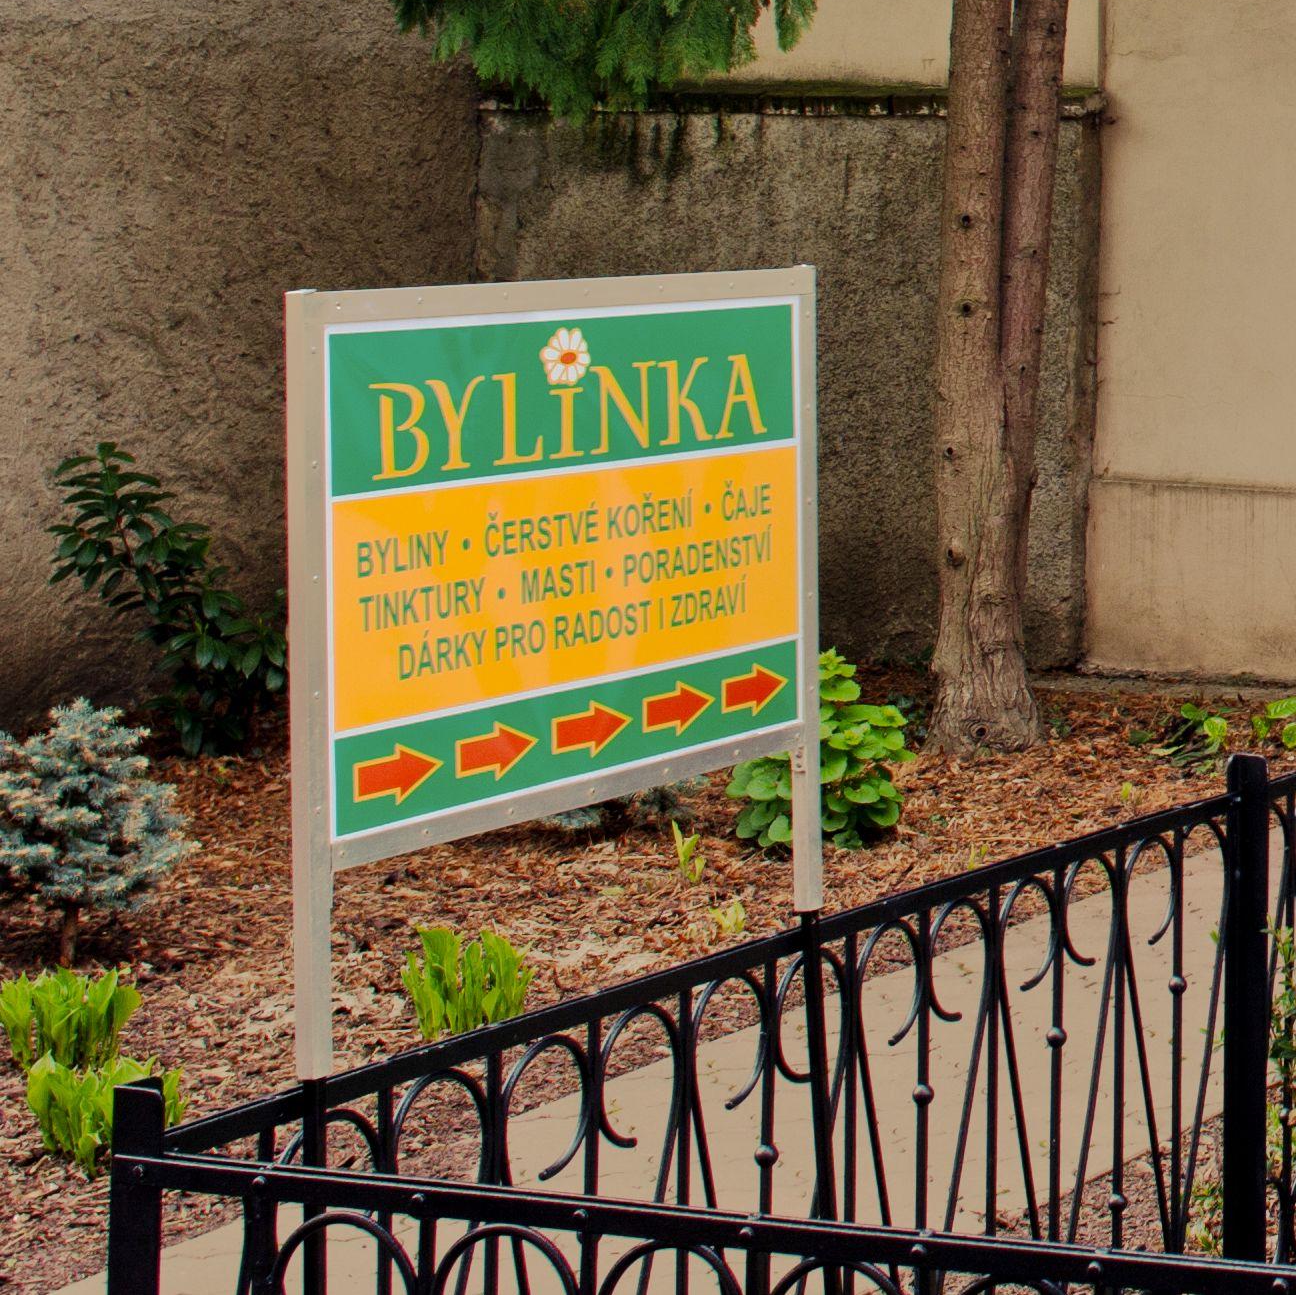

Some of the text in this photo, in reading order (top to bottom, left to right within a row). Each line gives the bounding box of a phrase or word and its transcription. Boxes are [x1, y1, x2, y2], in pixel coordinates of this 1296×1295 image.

[367, 353, 768, 481] BYLINKA
[356, 480, 773, 579] BYLINY ČERSTVÉ KOŘENÍ ČAJE
[358, 523, 773, 632] TINKTURY MASTI PORADENSTVÍ
[398, 573, 748, 681] DÁRKY PRO RADOST I ZDRAVÍ
